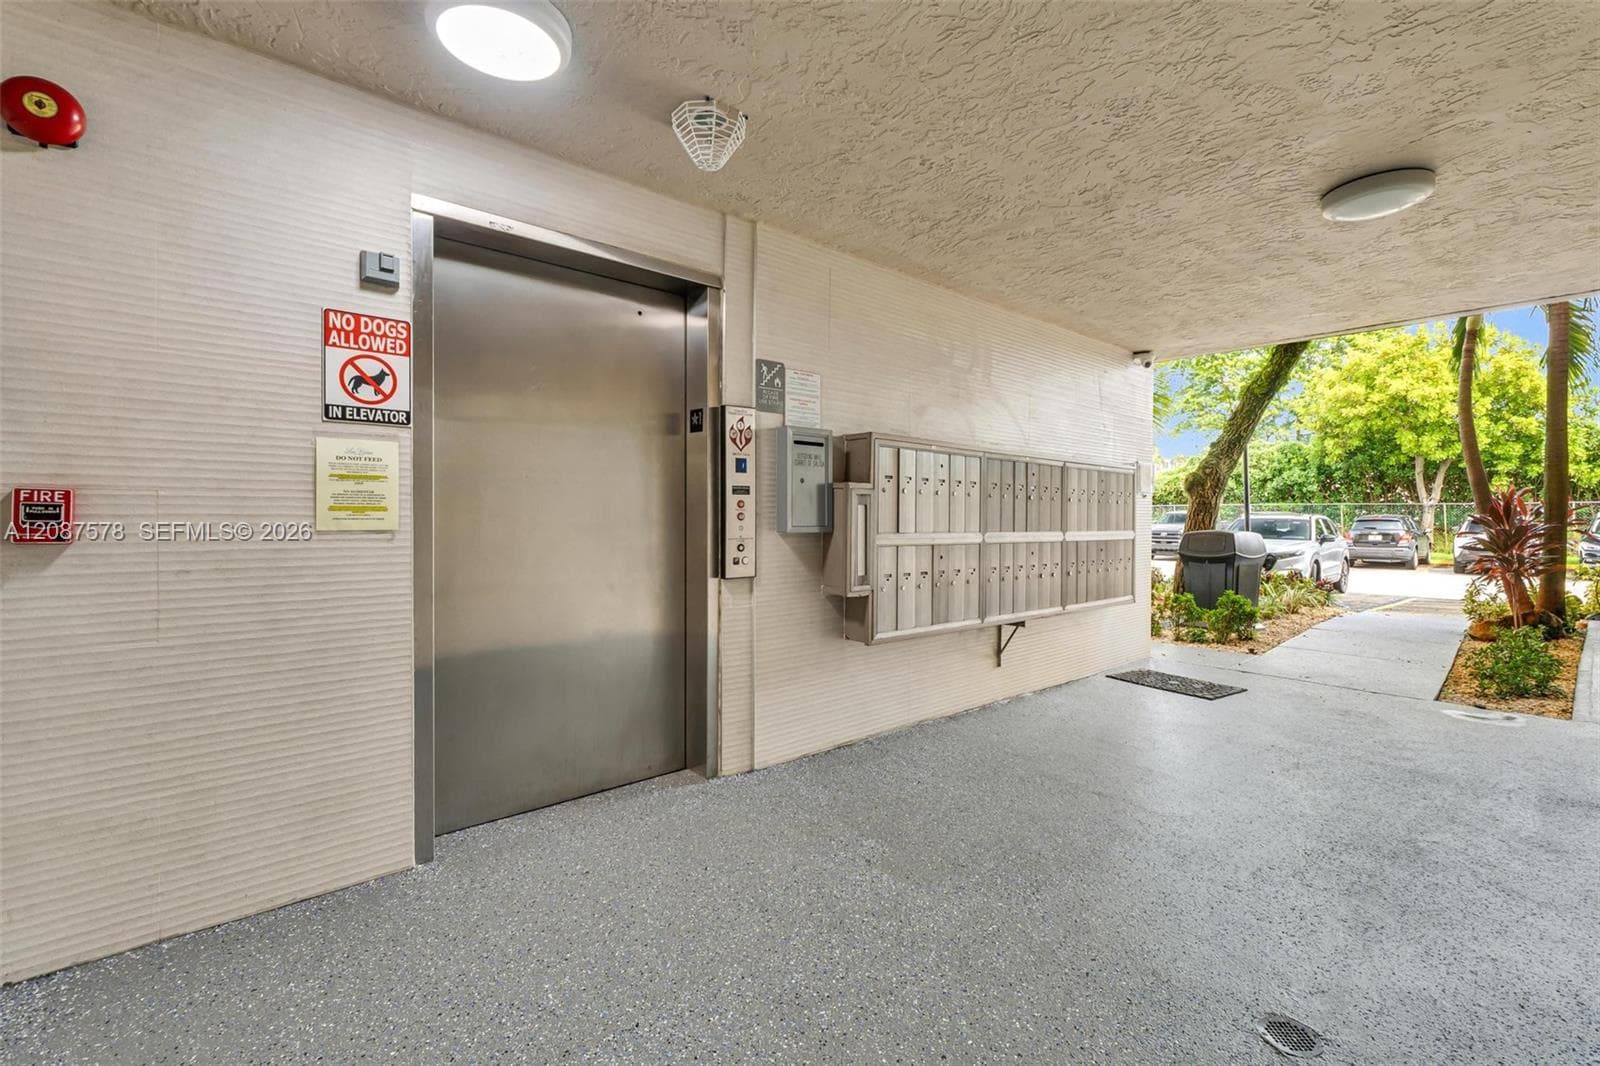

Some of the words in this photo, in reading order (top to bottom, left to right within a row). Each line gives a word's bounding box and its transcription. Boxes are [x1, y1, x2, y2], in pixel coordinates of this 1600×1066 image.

[328, 311, 355, 331] NO
[360, 317, 407, 339] DOGS
[328, 330, 406, 354] ALLOWED
[328, 405, 342, 418] IN
[345, 407, 407, 424] ELEVATOR
[20, 490, 65, 502] FIRE
